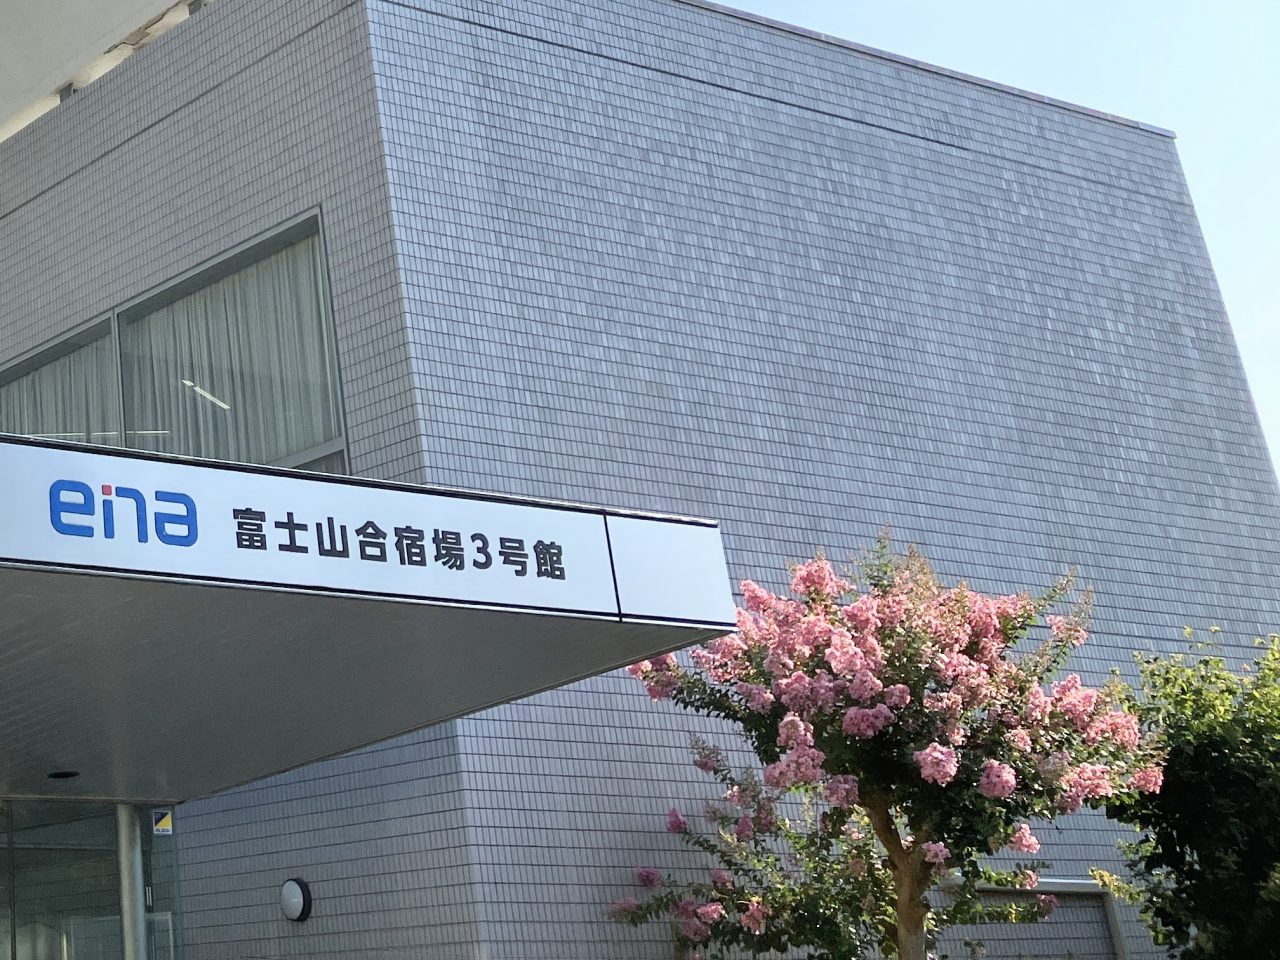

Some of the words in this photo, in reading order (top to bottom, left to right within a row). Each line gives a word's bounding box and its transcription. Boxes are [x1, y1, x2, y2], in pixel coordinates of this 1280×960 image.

[233, 507, 566, 581] 富士山合宿場3号館
